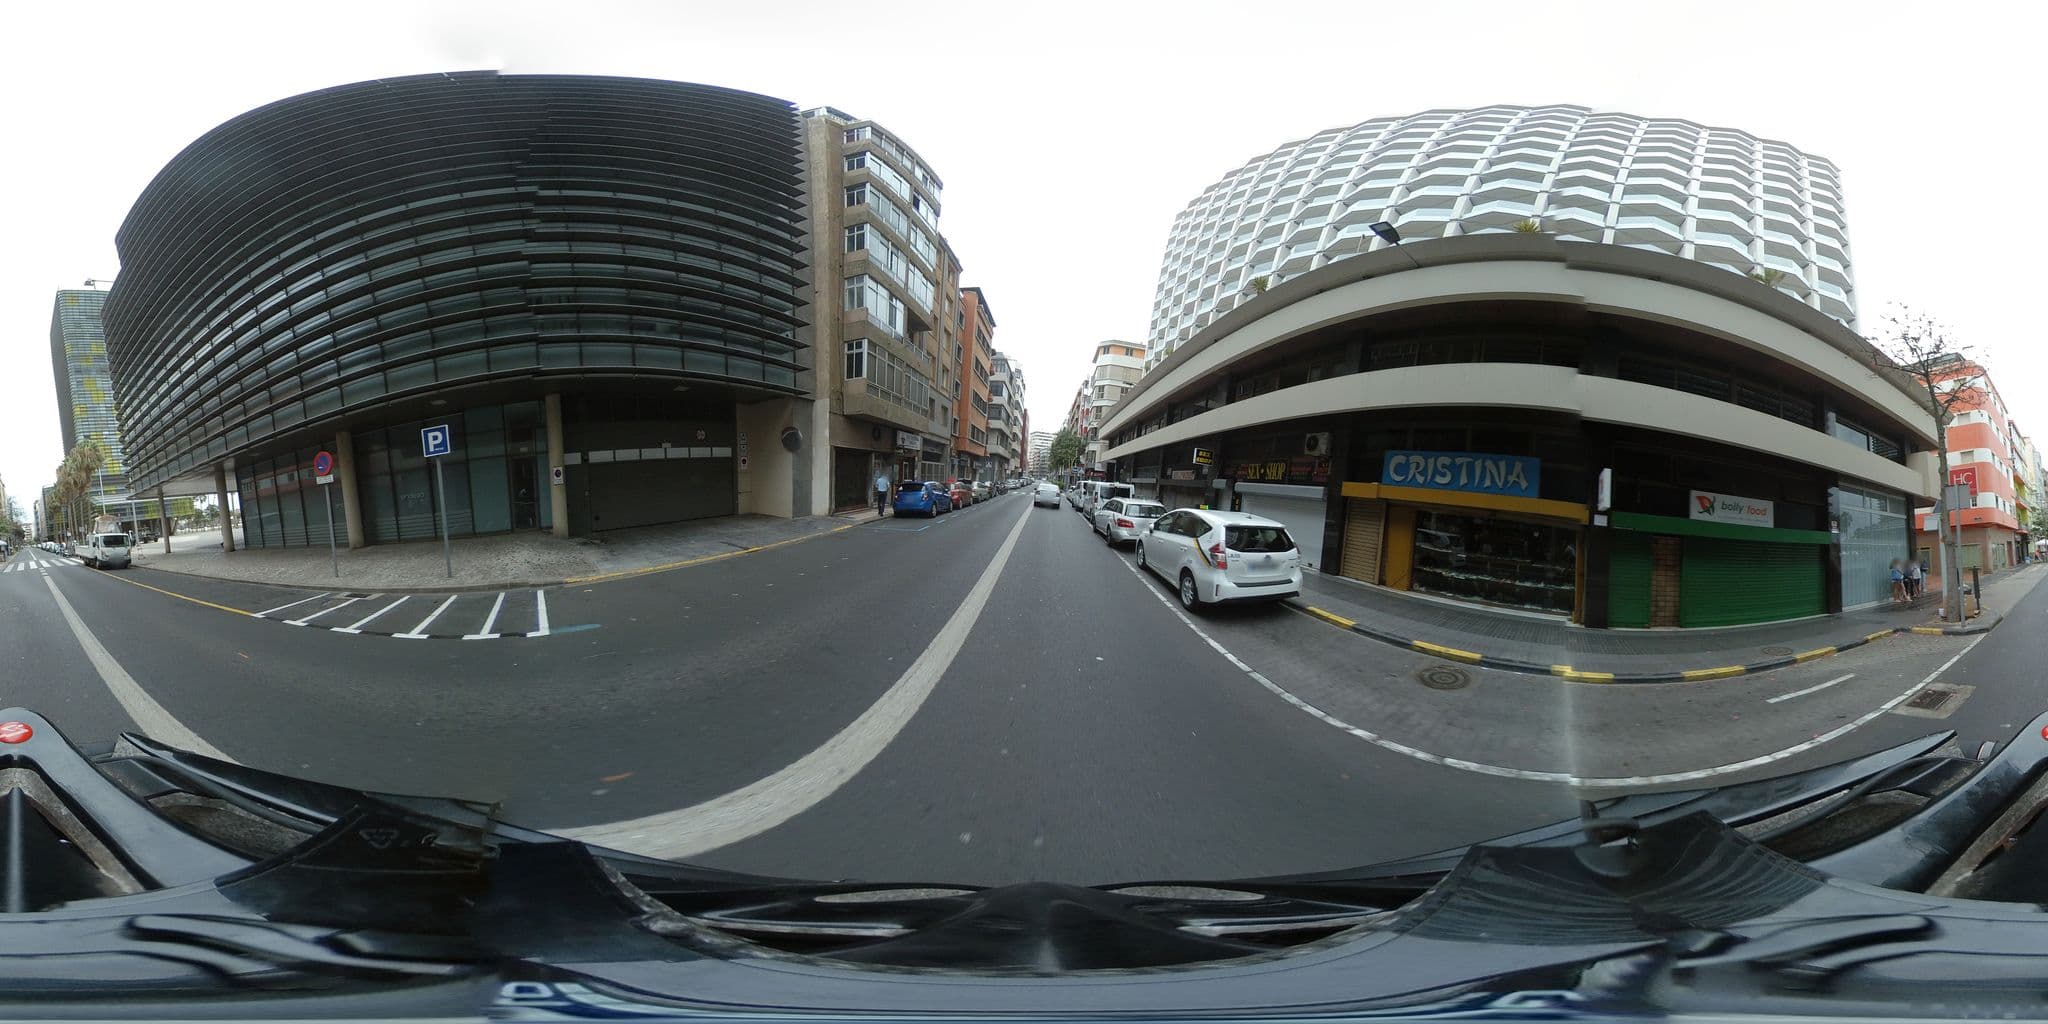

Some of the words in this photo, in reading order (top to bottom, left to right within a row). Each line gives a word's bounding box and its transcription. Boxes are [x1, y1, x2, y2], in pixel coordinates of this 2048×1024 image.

[428, 431, 443, 452] P
[1389, 455, 1529, 490] CRISTINA
[1953, 472, 1972, 485] HC
[1720, 500, 1745, 514] bolly
[1747, 504, 1768, 516] food
